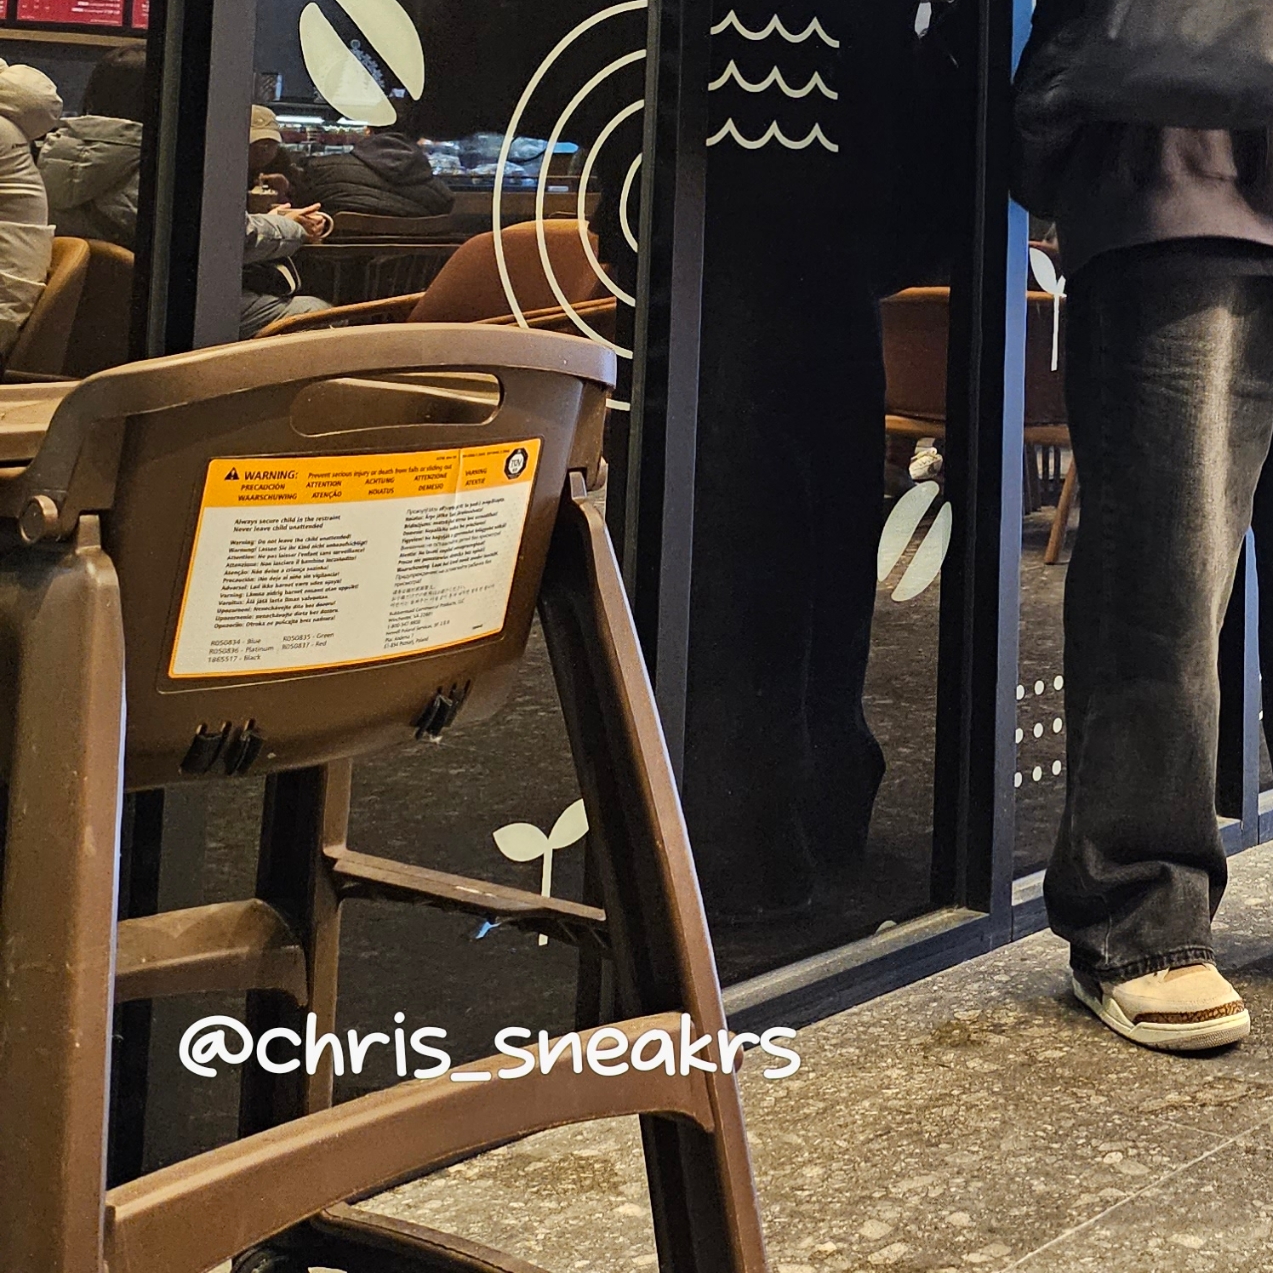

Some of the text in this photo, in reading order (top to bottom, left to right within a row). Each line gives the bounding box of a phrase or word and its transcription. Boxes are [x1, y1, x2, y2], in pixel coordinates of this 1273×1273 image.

[244, 470, 298, 480] WARNING:
[306, 480, 342, 488] ATTENTION
[365, 477, 395, 485] ACHTUNG
[414, 472, 447, 482] ATTENZIONE
[238, 493, 298, 502] WAARSCHUWING
